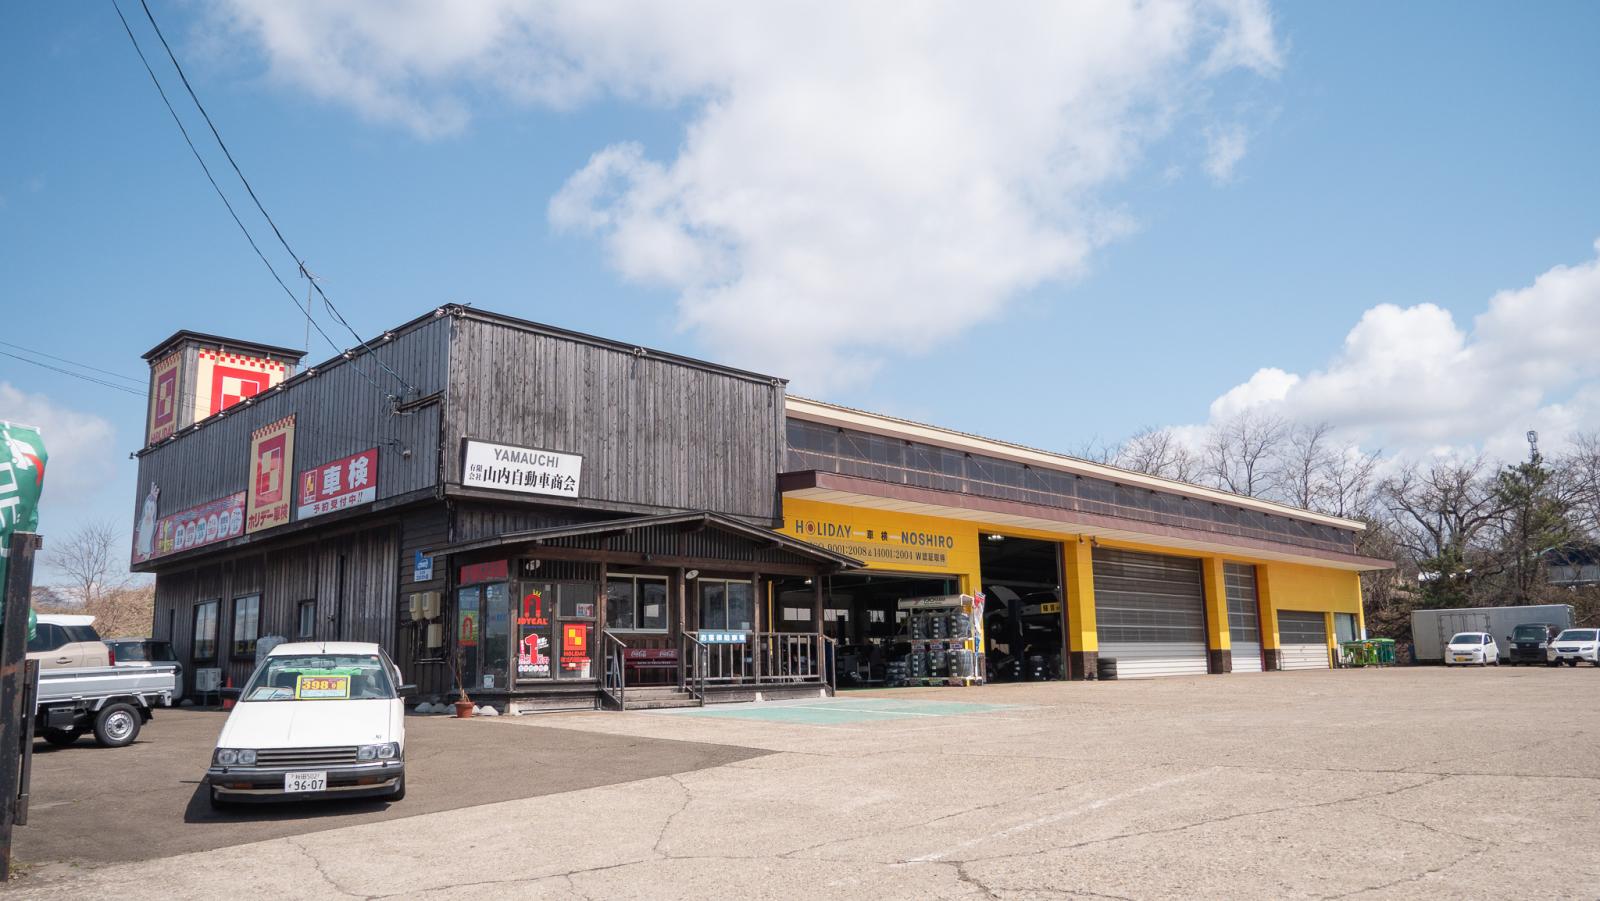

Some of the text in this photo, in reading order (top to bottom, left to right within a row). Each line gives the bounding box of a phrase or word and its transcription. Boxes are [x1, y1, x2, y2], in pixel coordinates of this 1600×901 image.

[494, 448, 559, 468] YAMAUCHI
[322, 456, 369, 495] 車検
[483, 466, 576, 492] 山内自動車商会
[247, 503, 288, 529] ホリデー車検
[795, 519, 954, 549] HOLIDAY 車検 NOSHIRO
